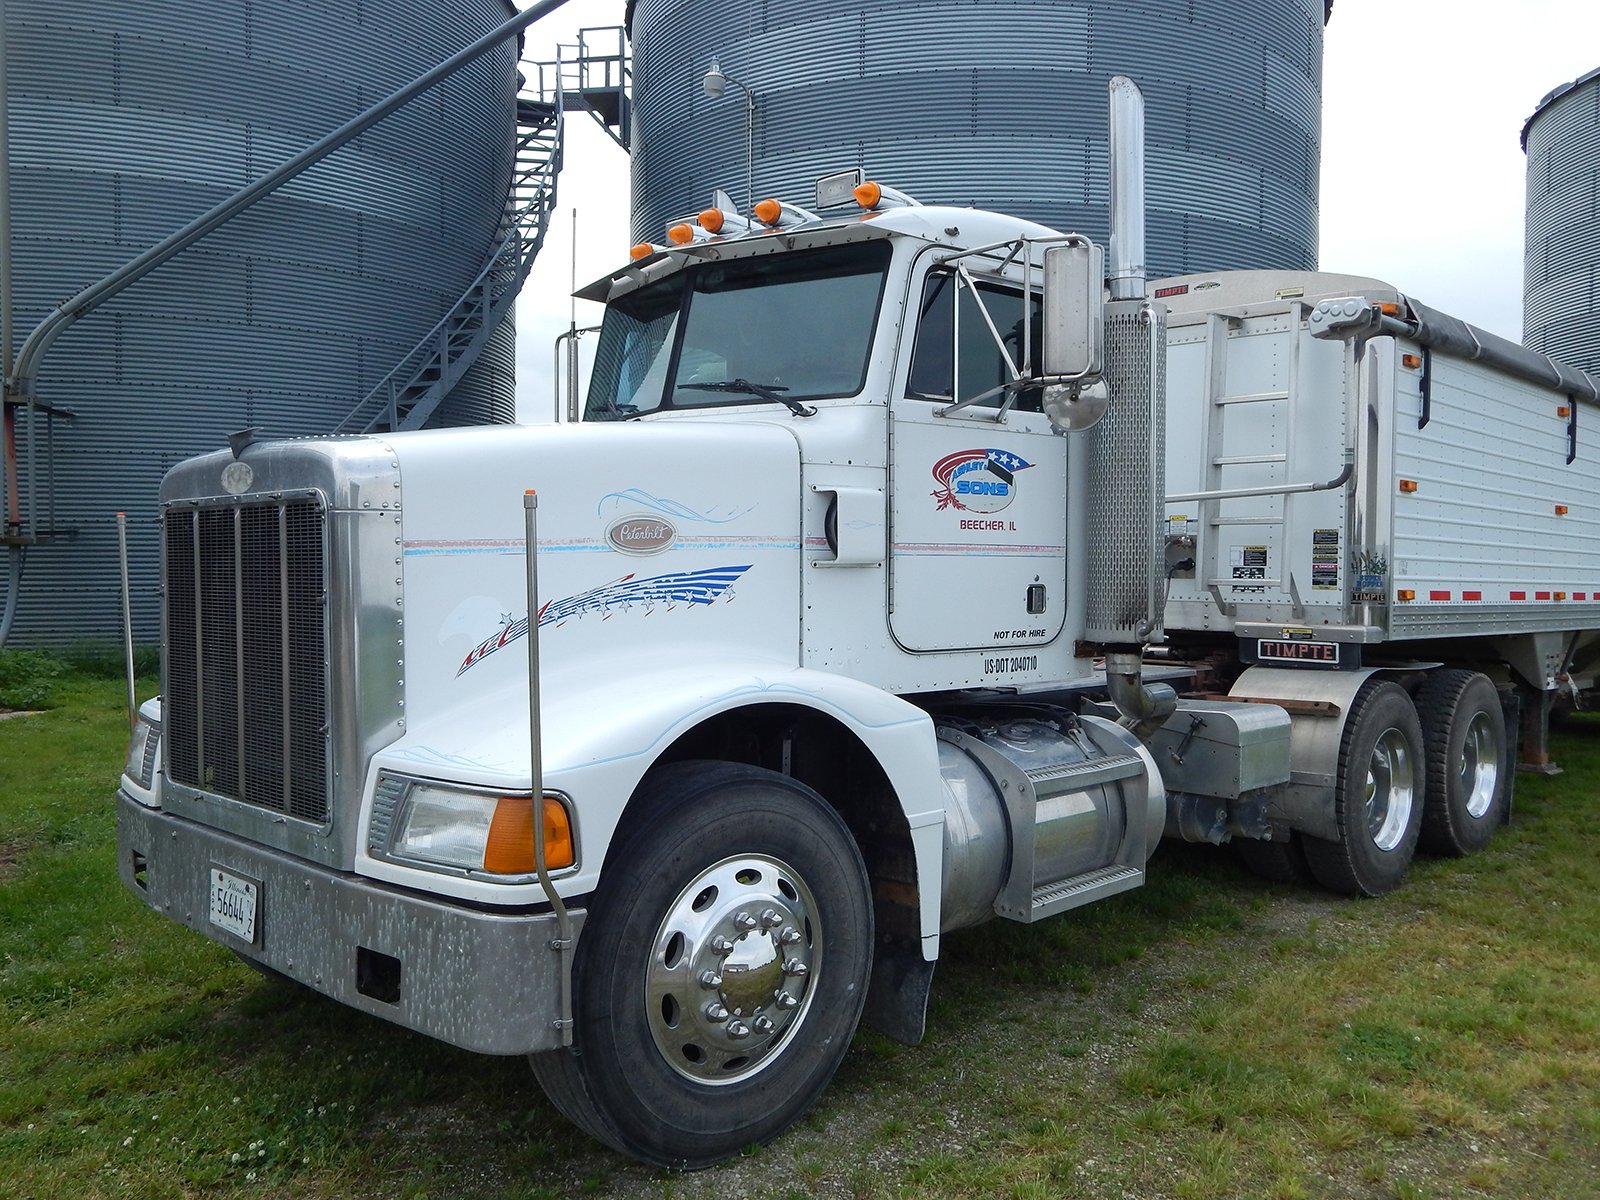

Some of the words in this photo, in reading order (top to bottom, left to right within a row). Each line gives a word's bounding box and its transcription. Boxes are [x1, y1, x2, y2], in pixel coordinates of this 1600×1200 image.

[1156, 286, 1187, 297] TIMPTE
[955, 480, 1009, 496] SONS
[620, 524, 668, 541] Peterbilt
[1009, 521, 1017, 531] IL
[1354, 592, 1385, 601] TIMPTE
[993, 631, 1010, 640] NOT
[1011, 630, 1027, 639] FOR
[1028, 628, 1046, 637] HIRE
[1264, 642, 1334, 660] TIMPTE
[1010, 655, 1038, 672] 2040710
[217, 887, 244, 925] 56644
